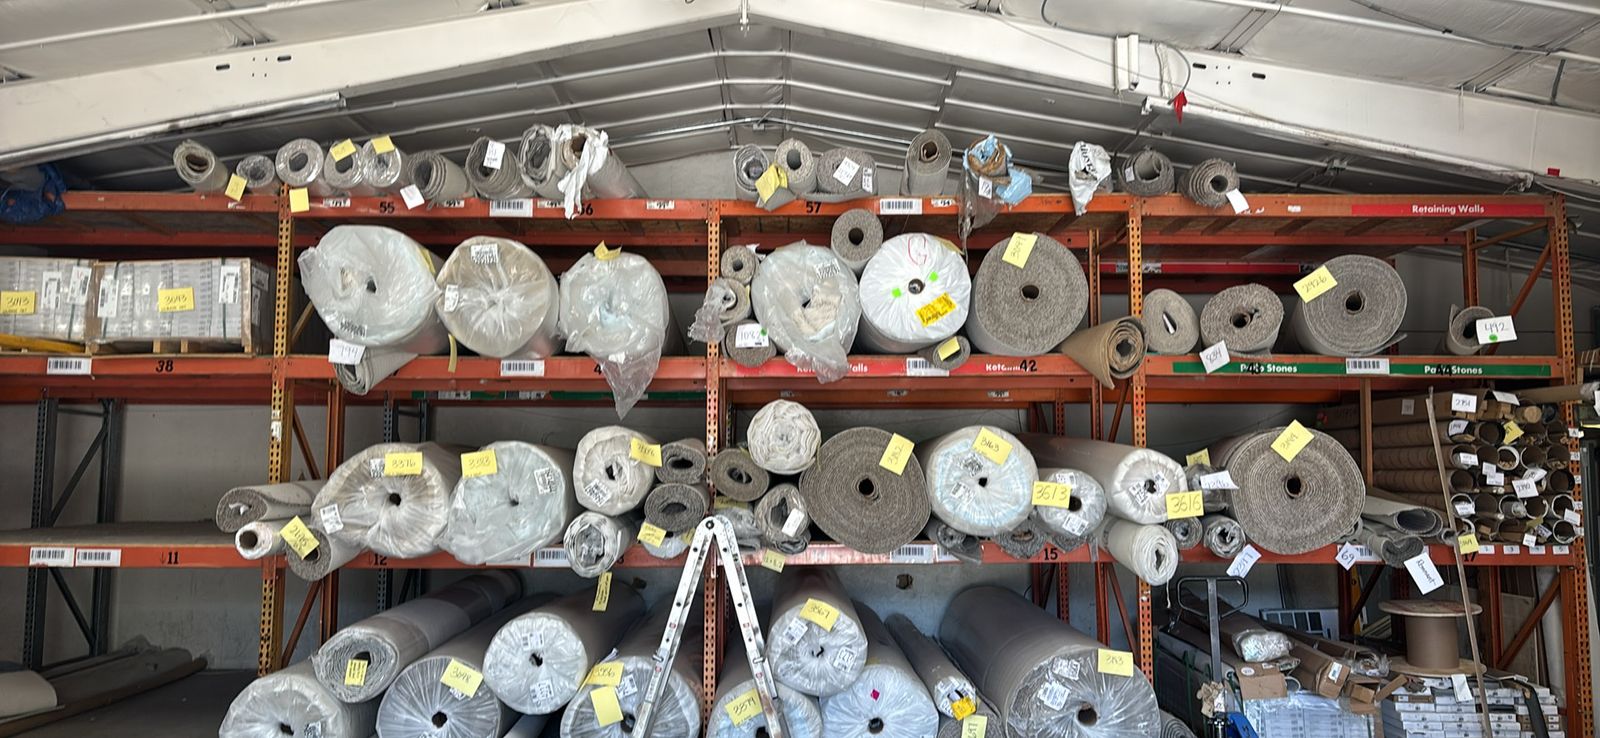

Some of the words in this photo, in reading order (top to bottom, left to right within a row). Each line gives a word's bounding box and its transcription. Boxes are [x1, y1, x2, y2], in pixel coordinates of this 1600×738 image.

[379, 202, 395, 214] 55
[805, 201, 822, 214] 57
[1412, 204, 1456, 215] Retaining
[1458, 204, 1485, 214] Walls
[156, 360, 174, 372] 38
[1020, 359, 1038, 372] 42
[1266, 364, 1298, 373] Stones
[1451, 364, 1483, 374] Stones
[1035, 486, 1068, 500] 3613
[1174, 495, 1202, 513] 3616
[167, 552, 179, 564] 11
[373, 554, 388, 565] 12
[1043, 548, 1058, 560] 15
